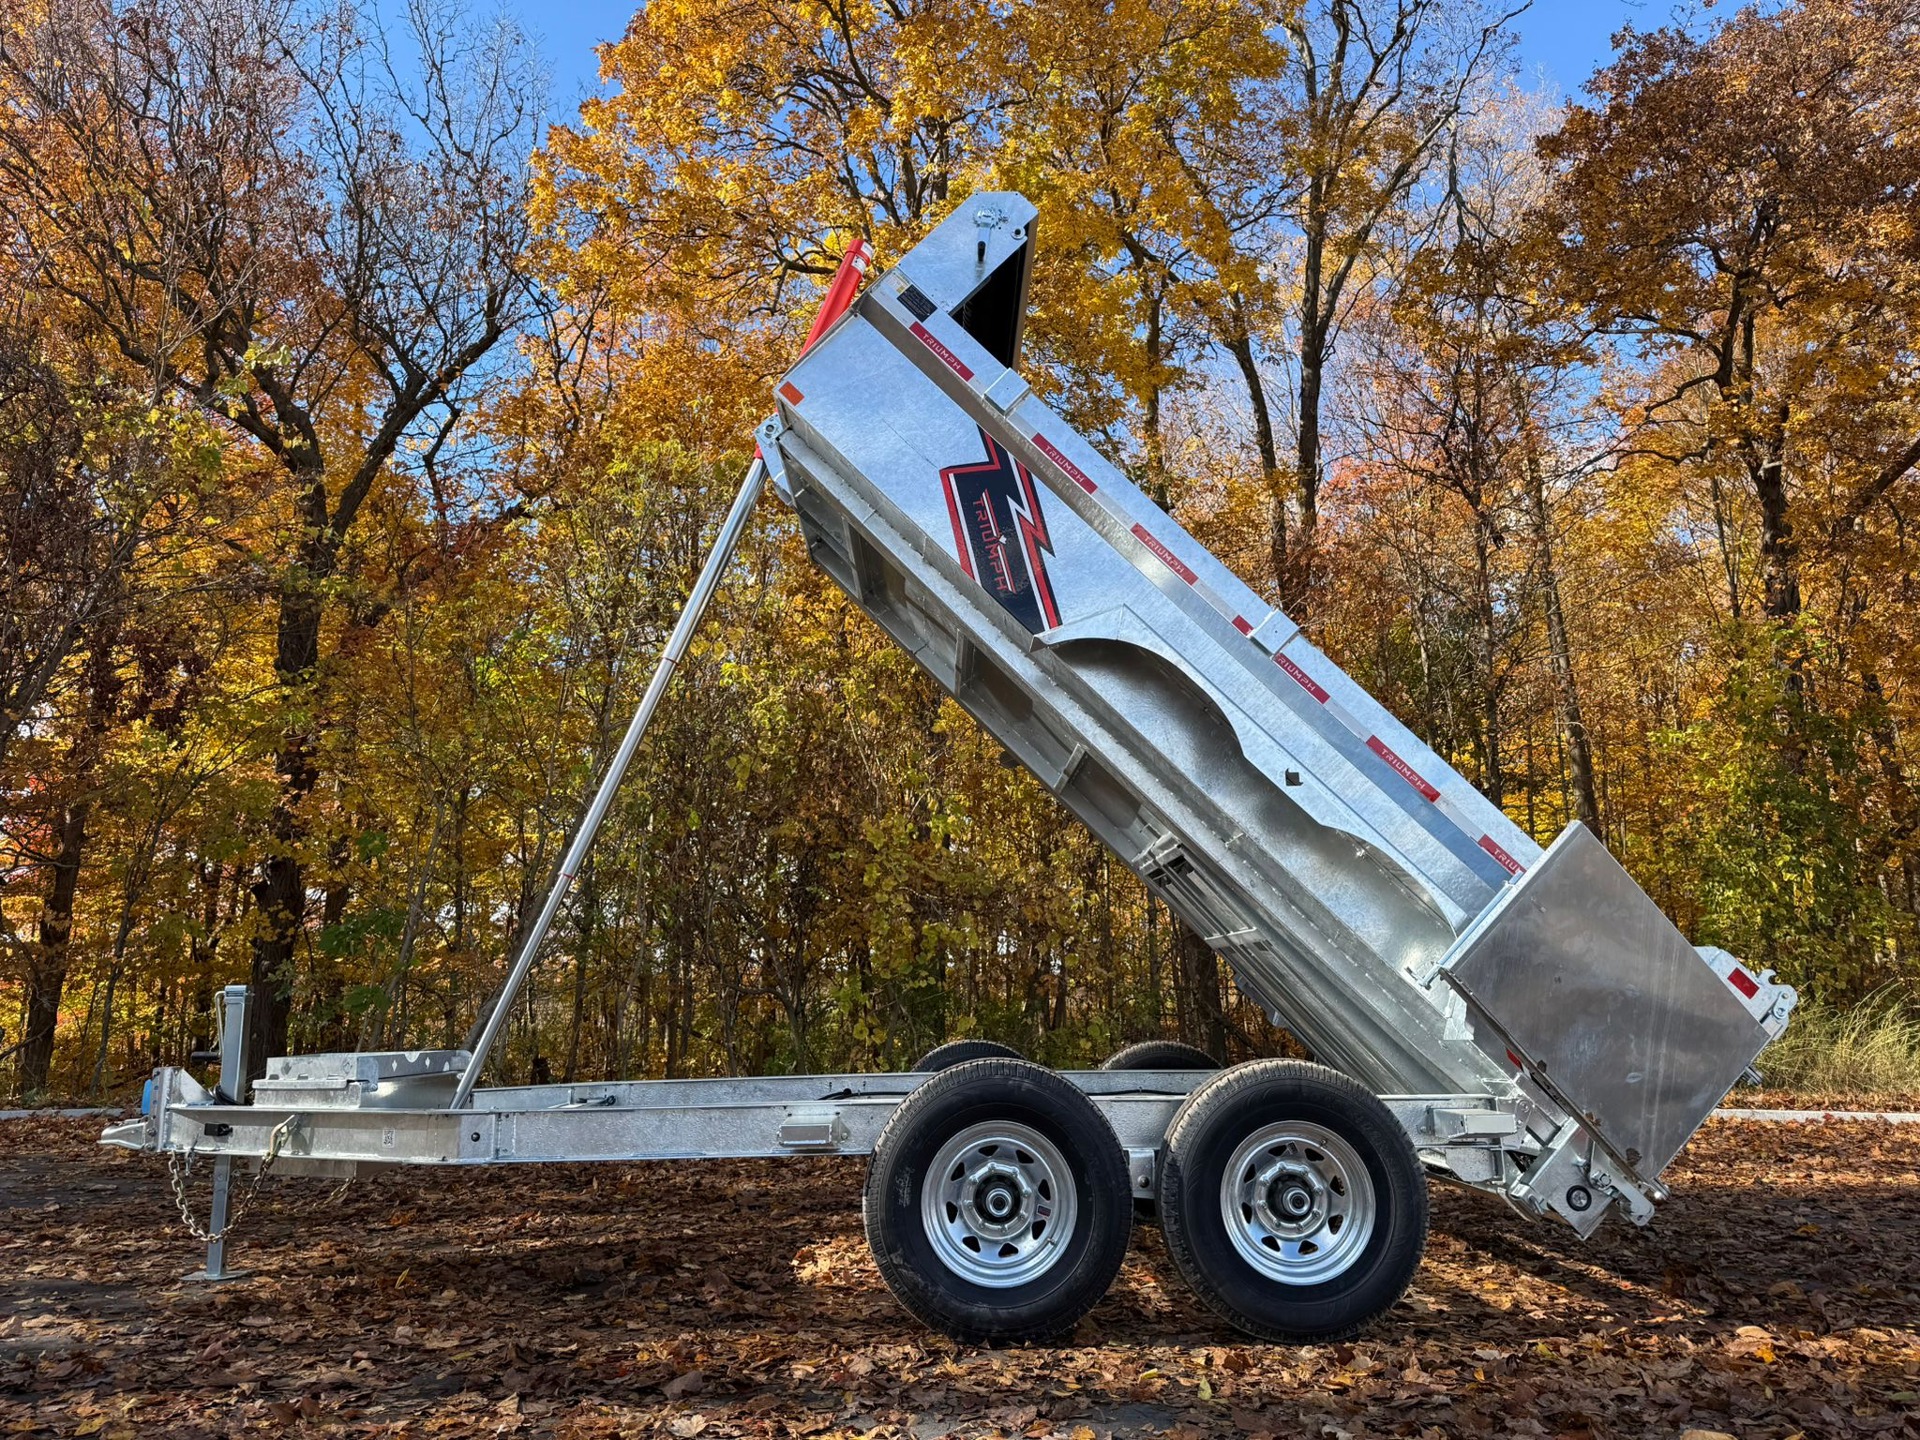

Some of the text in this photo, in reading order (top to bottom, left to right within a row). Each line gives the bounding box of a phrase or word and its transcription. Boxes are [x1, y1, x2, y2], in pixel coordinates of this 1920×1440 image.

[922, 333, 961, 370] TRIUMPH
[1045, 446, 1085, 482] TRIUMPH
[973, 497, 1008, 590] TRIUMPH
[1144, 536, 1185, 573] TRIUMPH
[1277, 656, 1316, 692] RIUMPH
[1382, 749, 1426, 789] TRIUMPH
